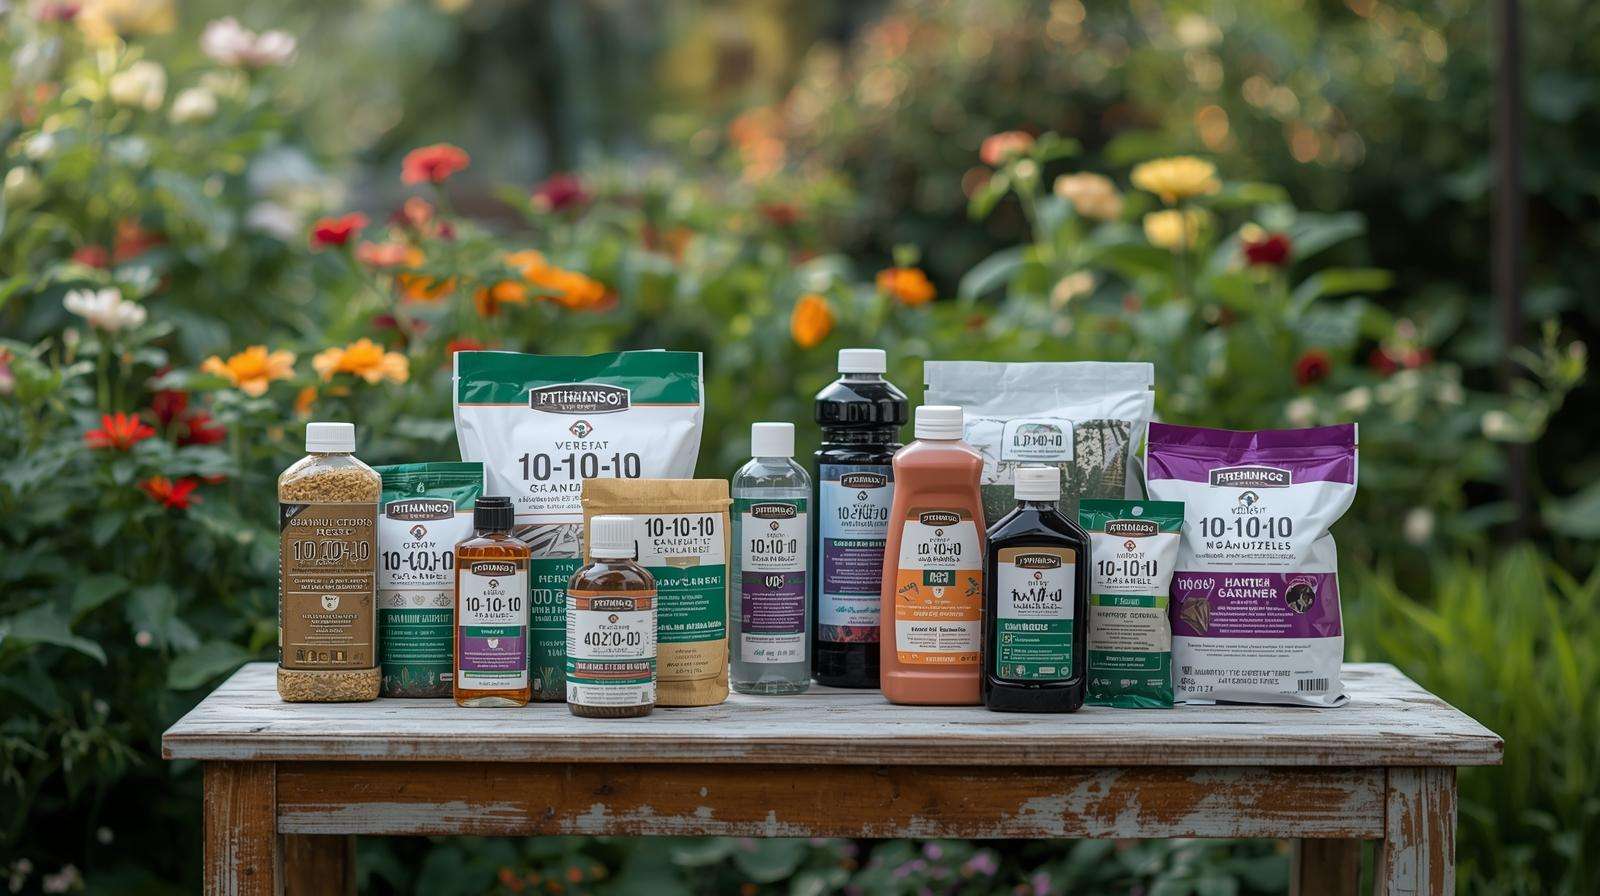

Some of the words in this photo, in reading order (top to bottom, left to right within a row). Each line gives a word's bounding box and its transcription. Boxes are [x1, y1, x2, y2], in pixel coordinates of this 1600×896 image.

[518, 452, 641, 481] 10-10-10
[645, 516, 714, 537] 10-10-10
[1199, 516, 1293, 538] 10-10-10
